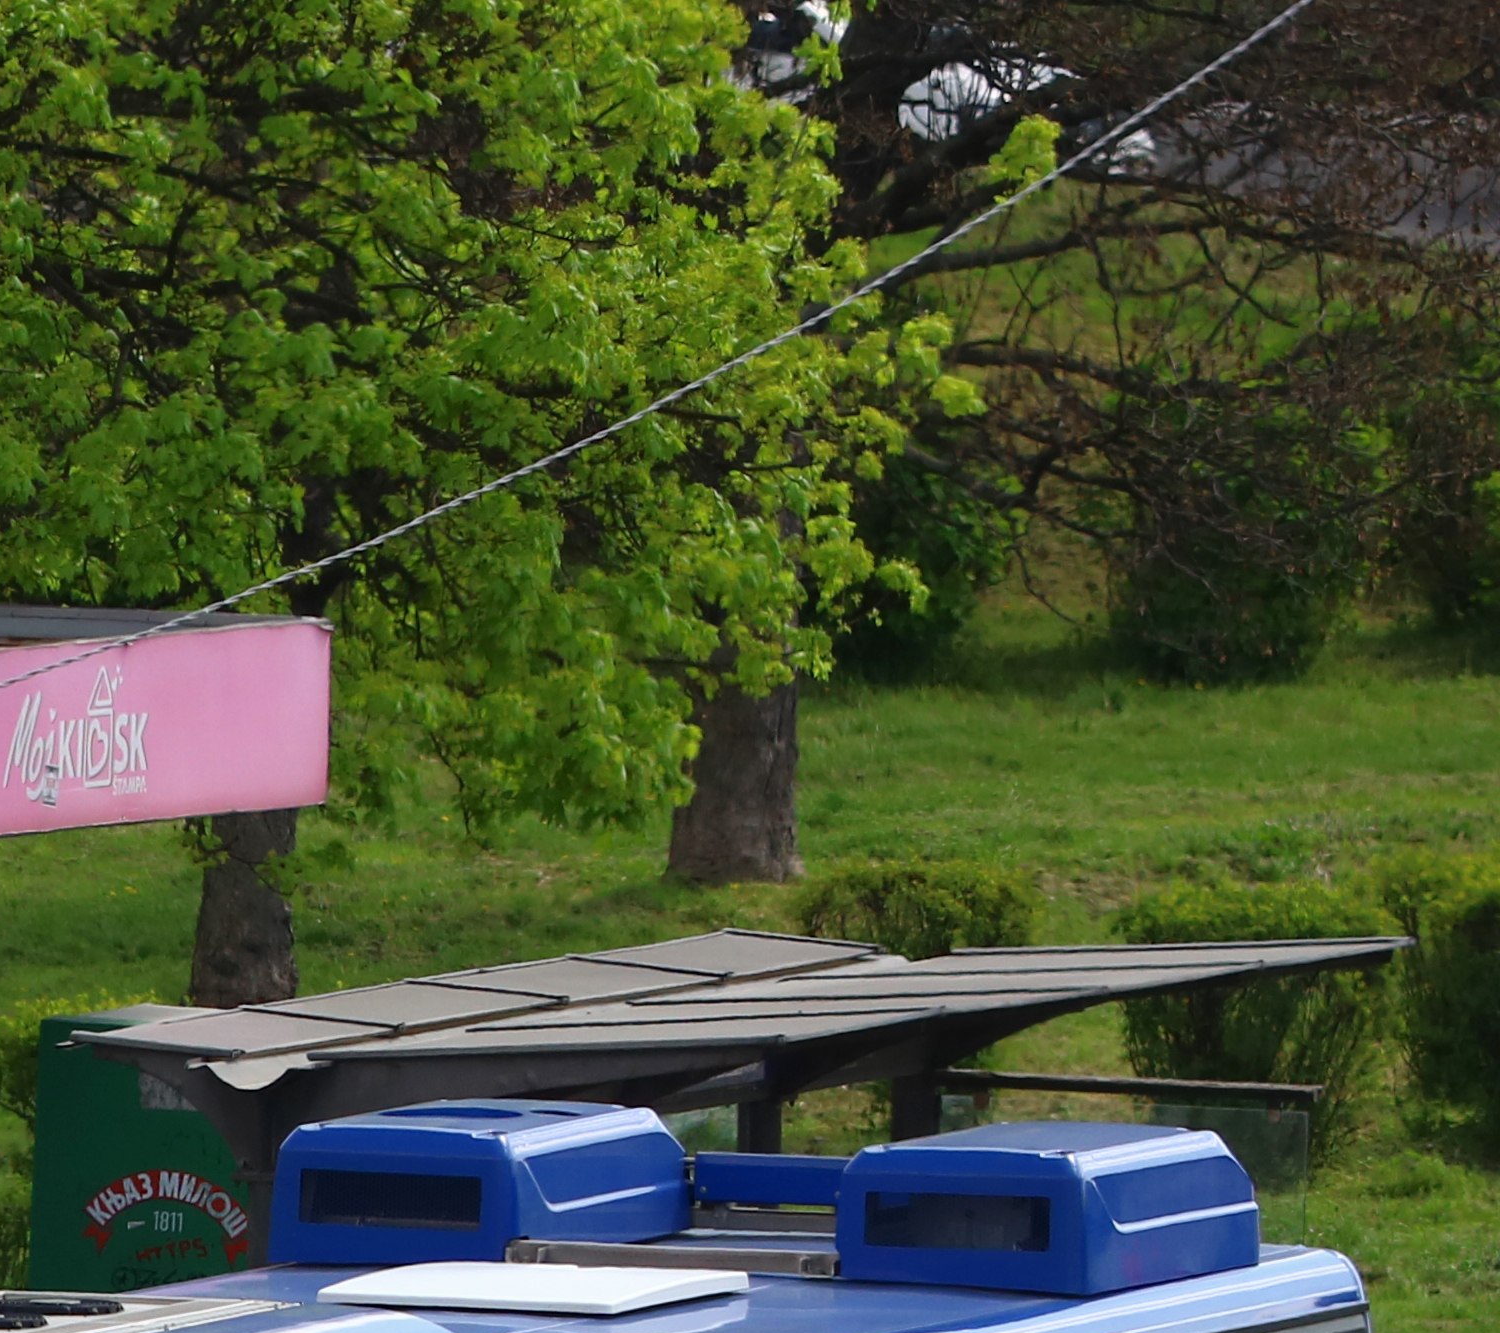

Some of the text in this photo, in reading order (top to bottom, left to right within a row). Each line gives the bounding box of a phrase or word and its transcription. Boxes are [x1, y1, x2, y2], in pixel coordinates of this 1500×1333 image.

[85, 1170, 248, 1239] КЊАЗ МИЛОШ
[153, 1211, 183, 1233] 1811
